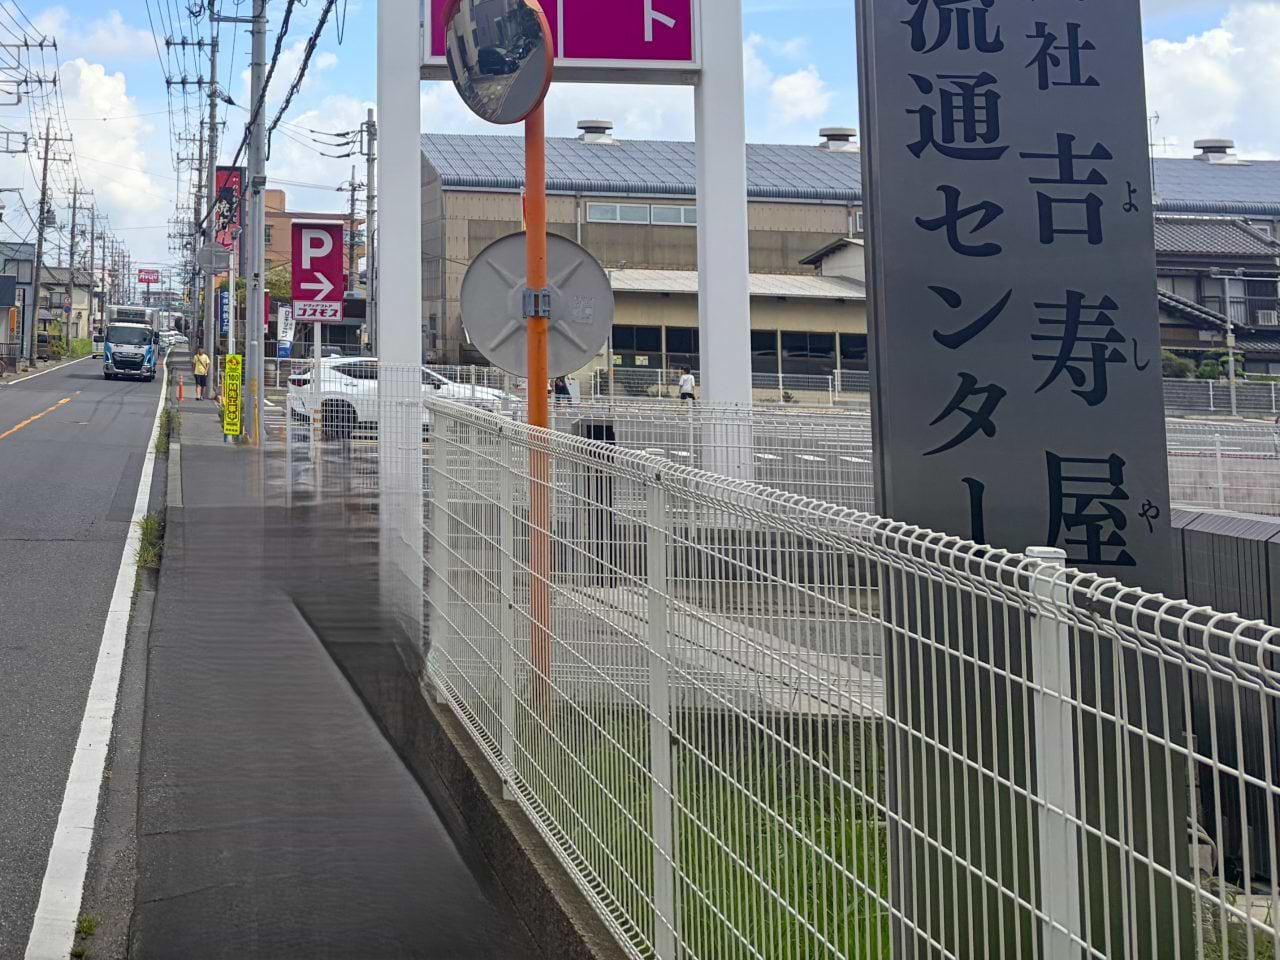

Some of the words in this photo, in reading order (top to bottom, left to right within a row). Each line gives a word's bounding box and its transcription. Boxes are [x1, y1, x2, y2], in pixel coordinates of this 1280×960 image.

[301, 228, 333, 270] P
[296, 308, 338, 318] コスモス
